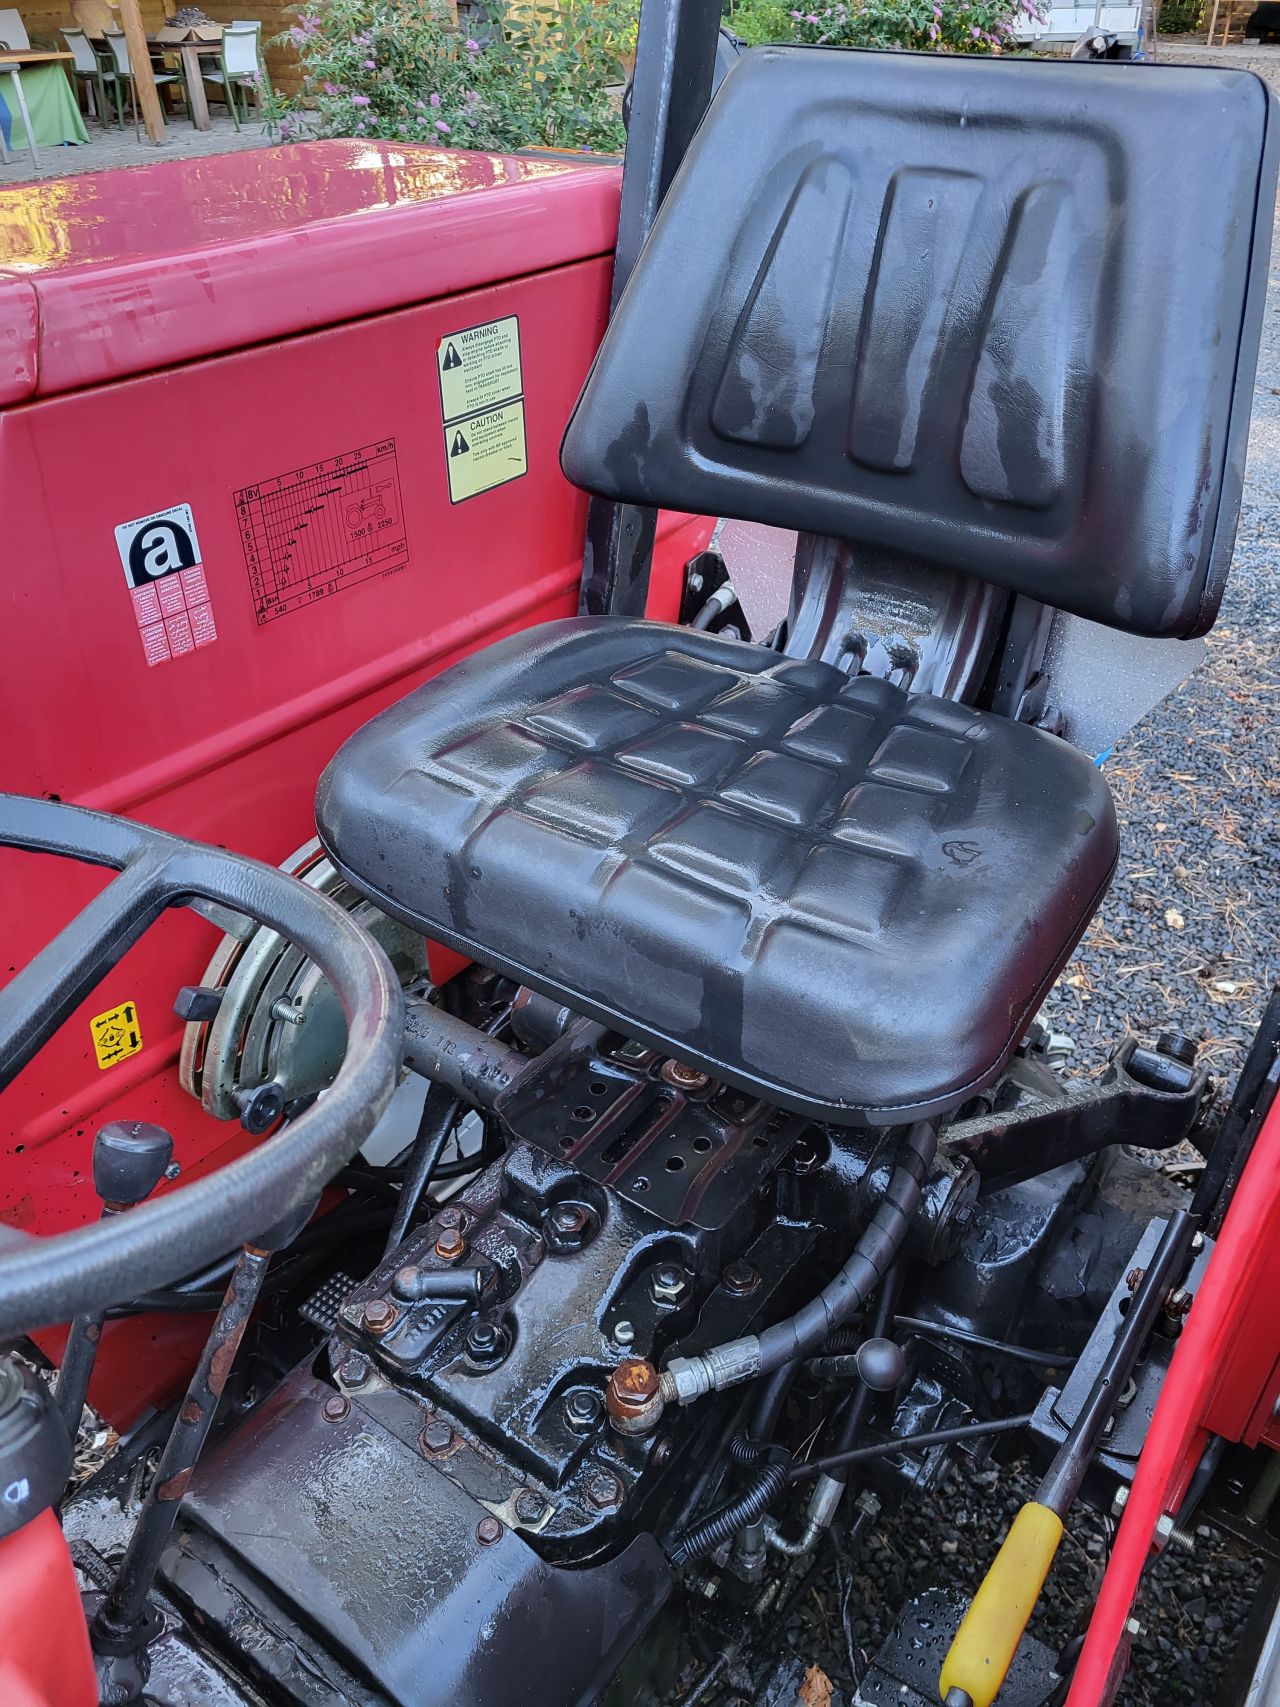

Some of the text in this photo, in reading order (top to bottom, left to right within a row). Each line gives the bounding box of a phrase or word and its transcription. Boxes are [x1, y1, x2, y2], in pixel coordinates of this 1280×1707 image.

[461, 325, 498, 344] WARNING
[470, 411, 504, 431] CAUTION
[296, 471, 304, 480] 10
[315, 465, 324, 473] 15
[335, 458, 343, 466] 20
[354, 452, 362, 460] 25
[350, 517, 392, 540] 1500 2250
[141, 527, 183, 576] a
[336, 568, 344, 577] 10
[365, 556, 373, 565] 15
[390, 542, 405, 554] mph
[274, 588, 324, 615] 540 1789
